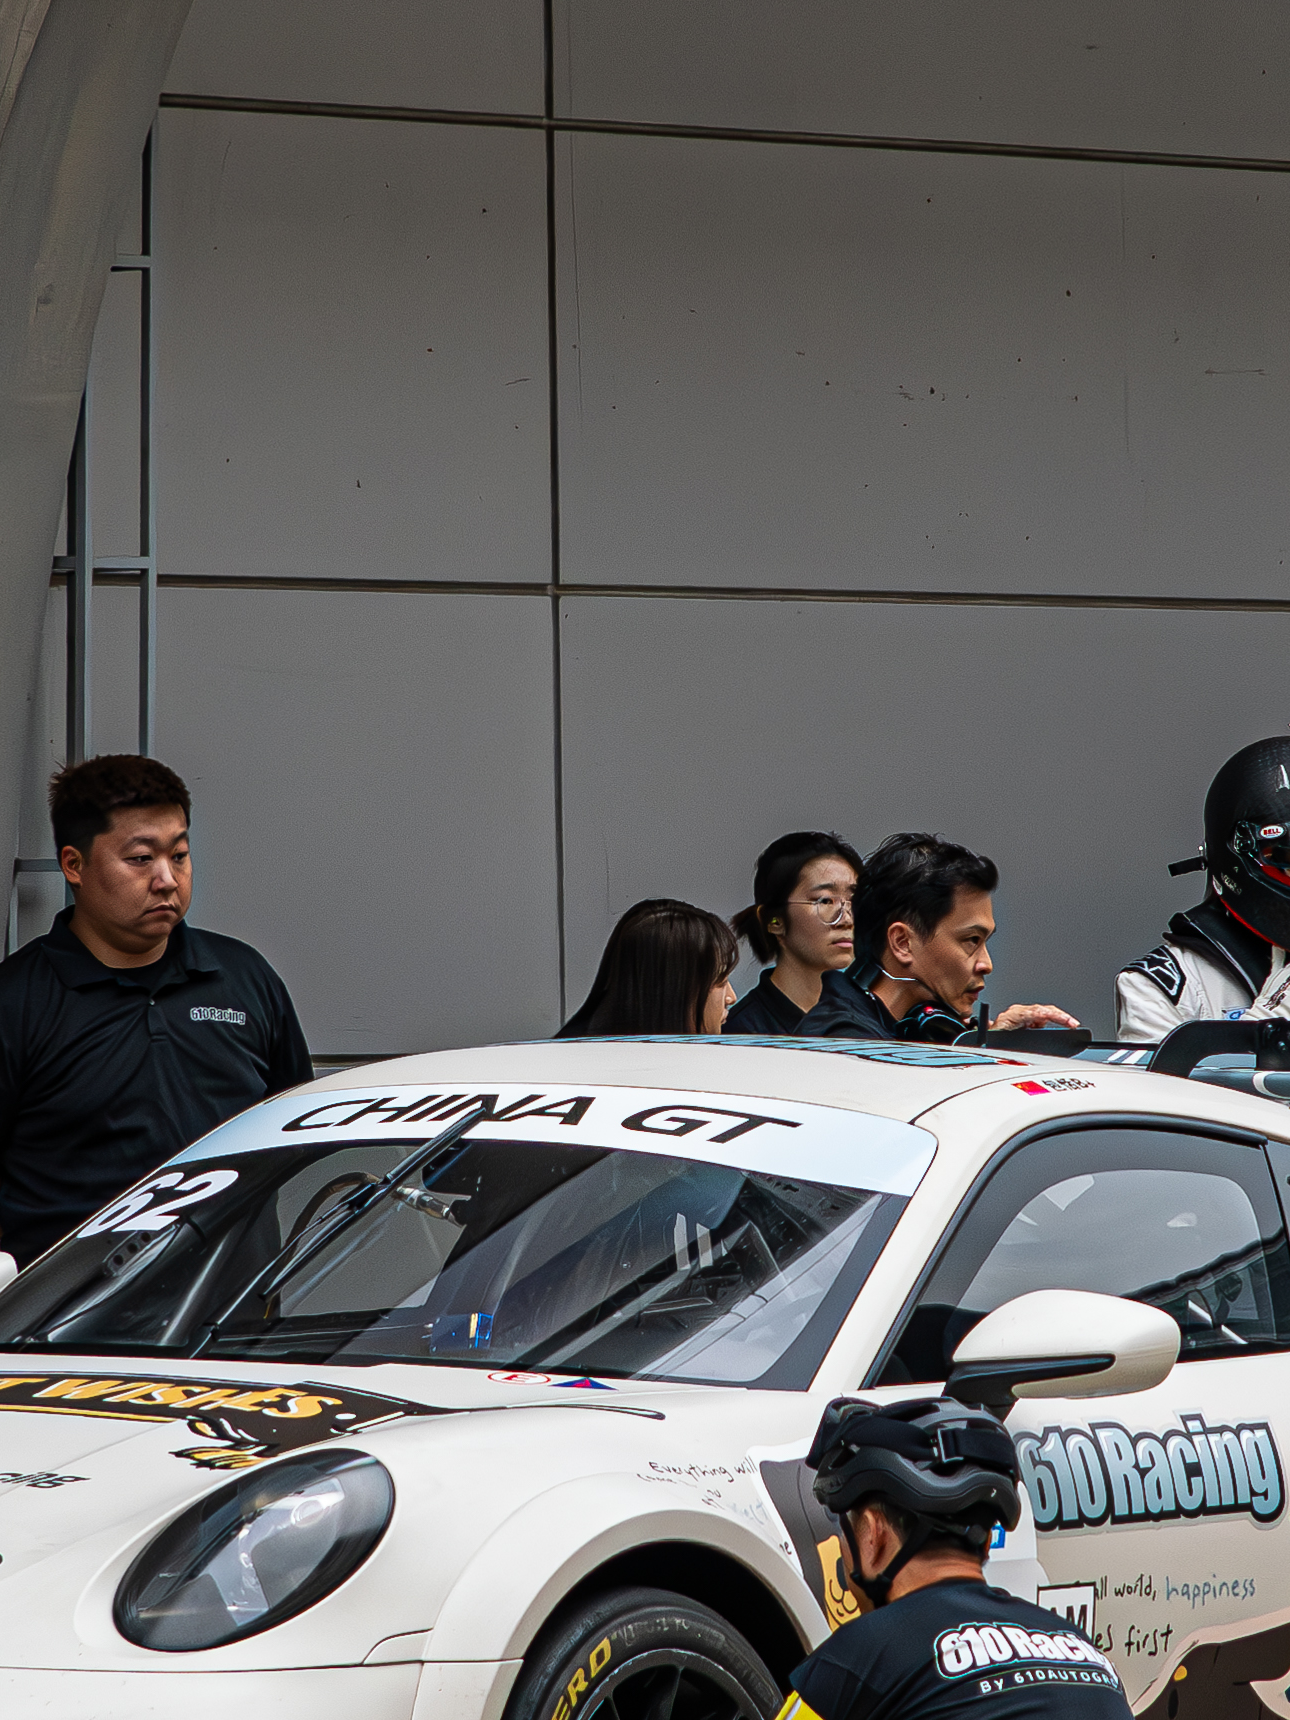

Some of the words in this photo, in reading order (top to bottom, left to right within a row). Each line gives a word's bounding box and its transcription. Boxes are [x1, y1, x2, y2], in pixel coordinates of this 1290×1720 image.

[282, 1094, 595, 1131] CHINA
[621, 1105, 803, 1143] GT
[77, 1170, 239, 1238] 62
[34, 1378, 342, 1418] WISHES
[648, 1461, 734, 1483] Everything
[734, 1455, 757, 1475] will
[1014, 1415, 1285, 1529] 610Racing
[1166, 1574, 1256, 1609] happiness
[940, 1626, 1118, 1673] 610Raci
[1125, 1623, 1173, 1657] first
[1014, 1669, 1118, 1688] 610AUTOGR
